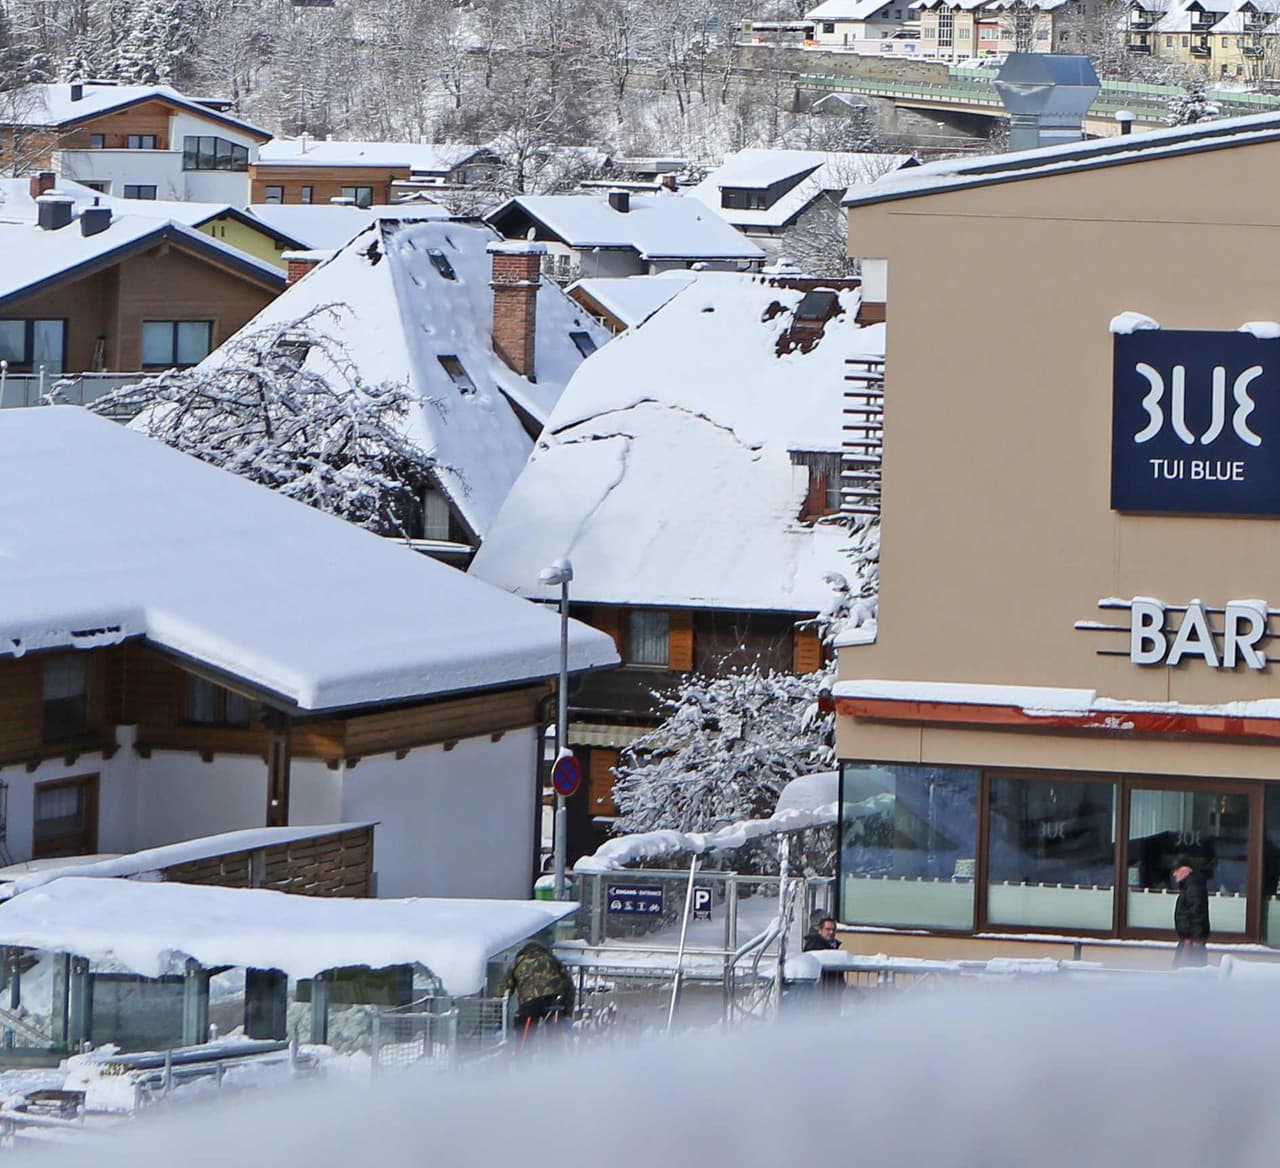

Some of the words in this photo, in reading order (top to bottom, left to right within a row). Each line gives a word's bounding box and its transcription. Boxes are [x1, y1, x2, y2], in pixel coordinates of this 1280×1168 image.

[1149, 459, 1184, 480] TUI
[1190, 459, 1245, 482] BLUE
[1130, 600, 1267, 670] BAR
[695, 890, 710, 909] P
